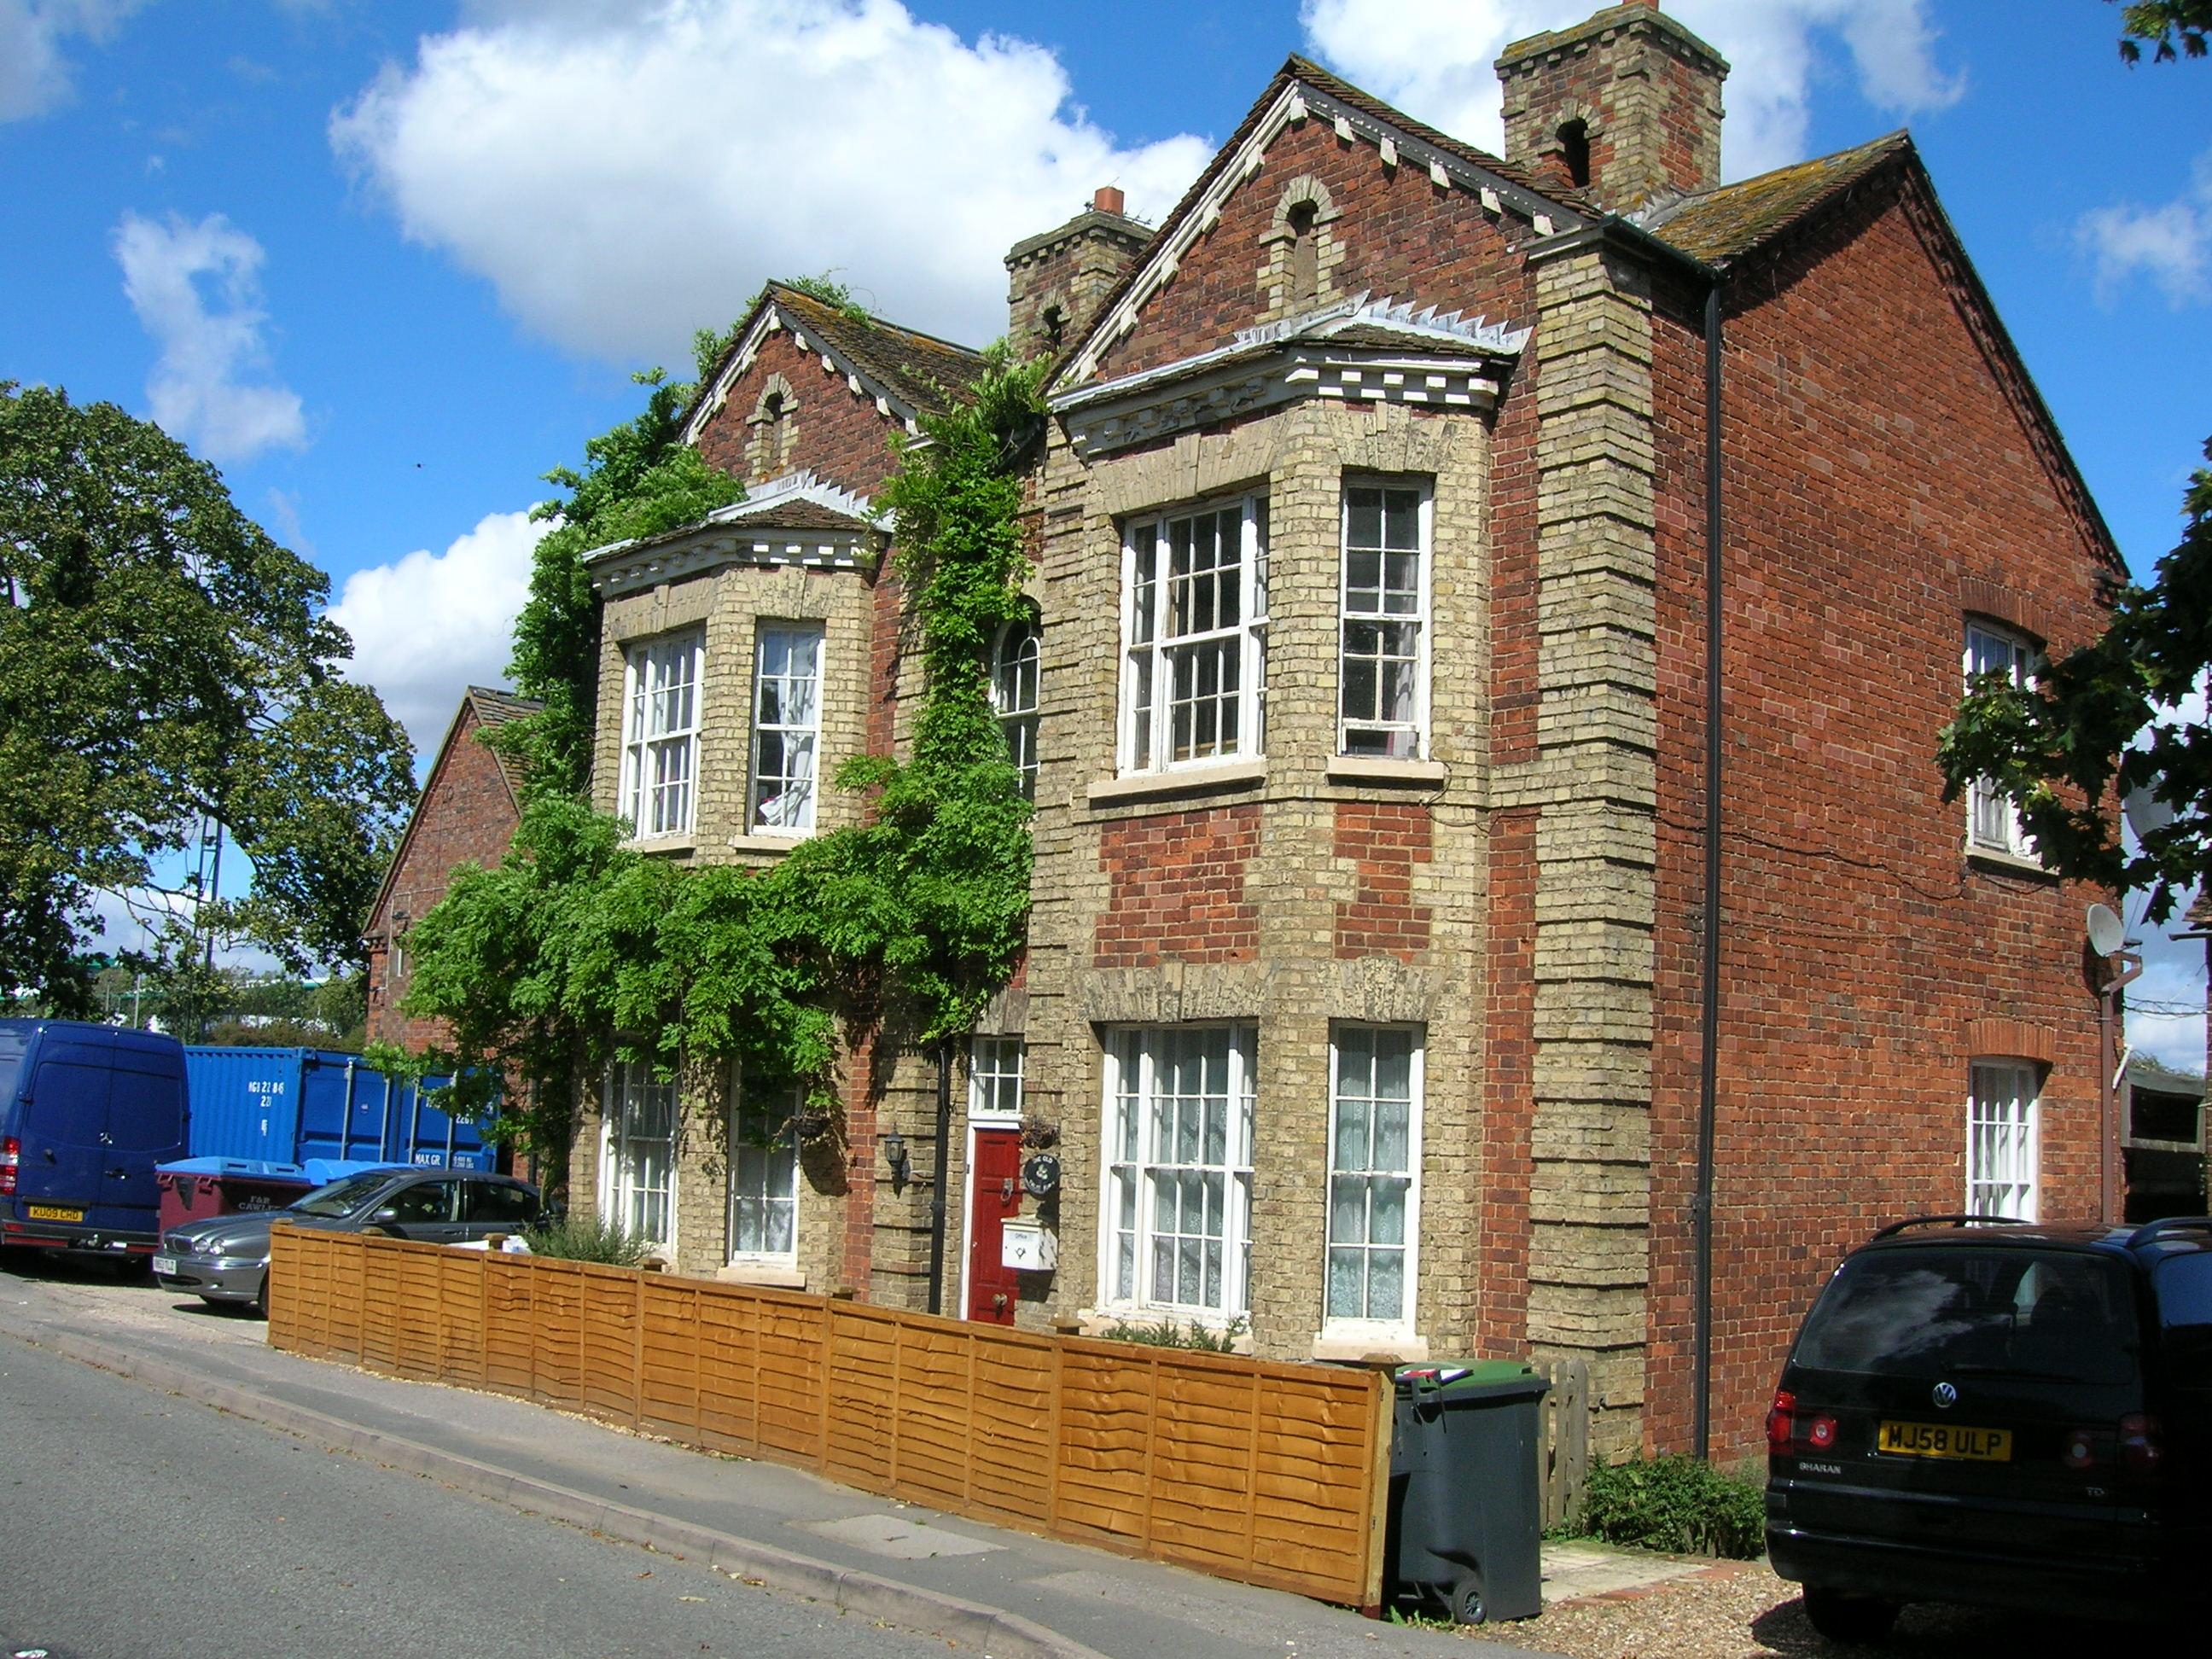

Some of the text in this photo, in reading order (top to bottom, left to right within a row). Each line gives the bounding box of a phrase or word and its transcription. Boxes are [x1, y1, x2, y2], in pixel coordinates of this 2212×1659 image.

[416, 1153, 430, 1165] MAX
[431, 1154, 441, 1166] GR
[1888, 1424, 2002, 1456] MJ58 ULP
